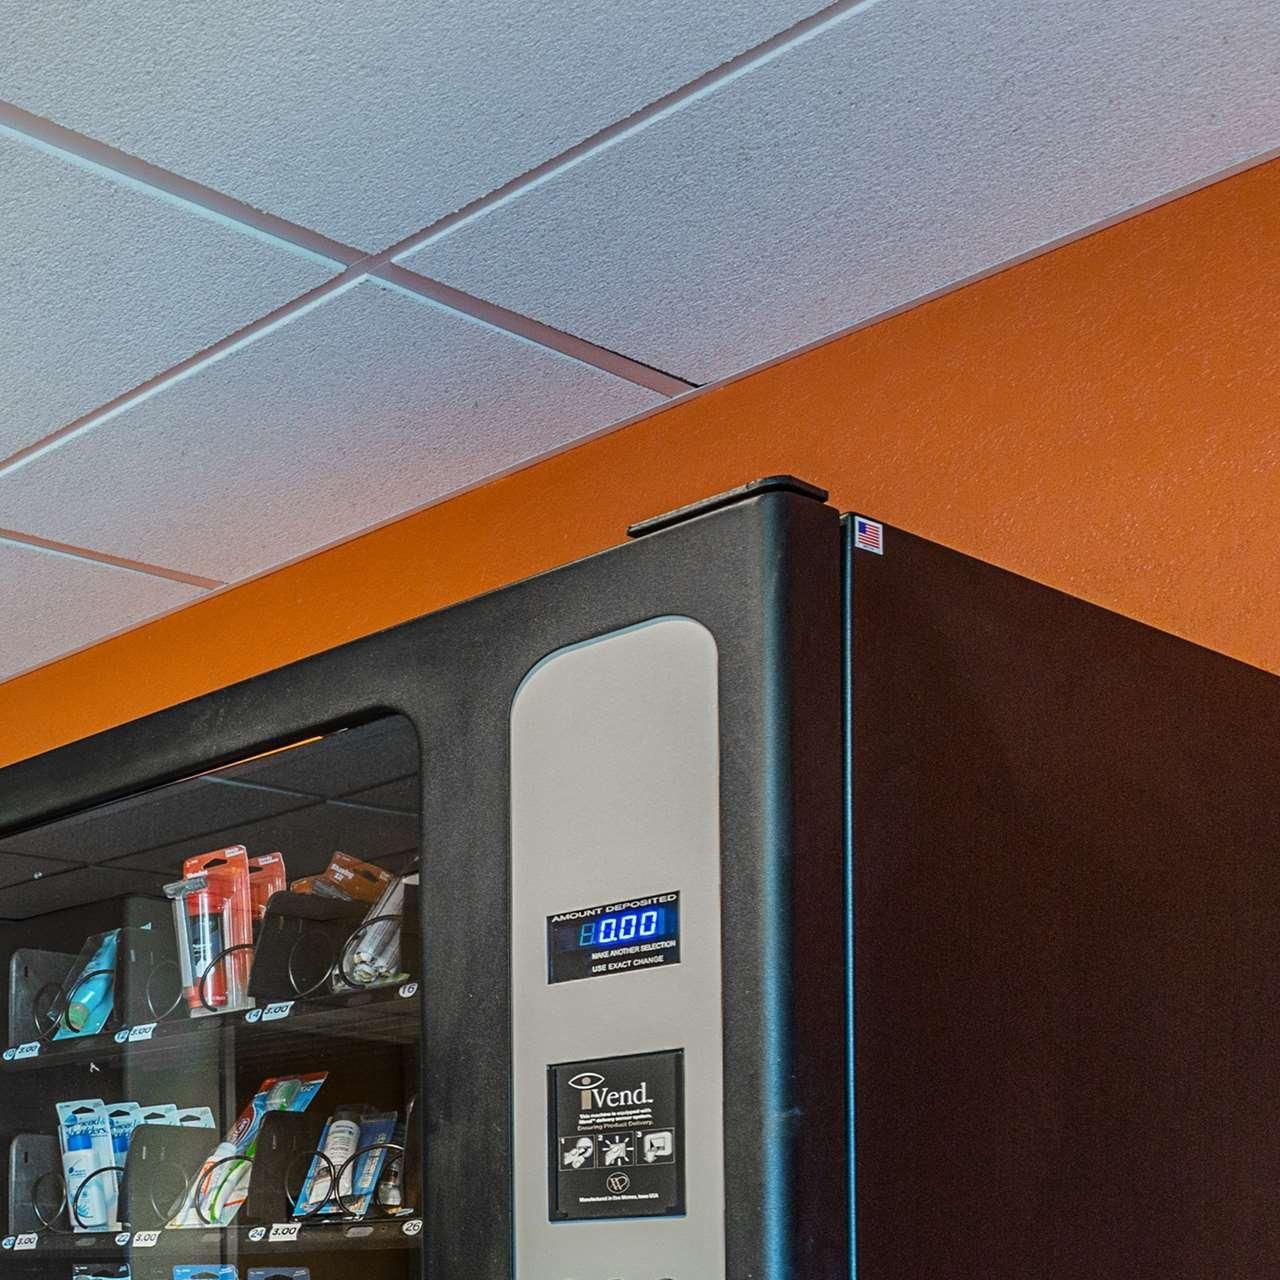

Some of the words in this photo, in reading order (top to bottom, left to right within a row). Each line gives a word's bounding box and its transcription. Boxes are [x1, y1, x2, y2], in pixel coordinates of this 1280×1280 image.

[551, 907, 603, 923] AMOUNT
[605, 894, 677, 913] DEPOSITED
[599, 911, 657, 943] 0.00
[592, 950, 609, 960] MAKE
[640, 940, 676, 953] SELECTION
[592, 964, 607, 973] USE
[608, 960, 632, 971] EXACT
[632, 955, 664, 966] CHANGE
[265, 1005, 290, 1014] 3.00
[136, 1233, 157, 1242] 3.00
[272, 1227, 296, 1236] 3.00
[17, 1237, 35, 1246] 3.00
